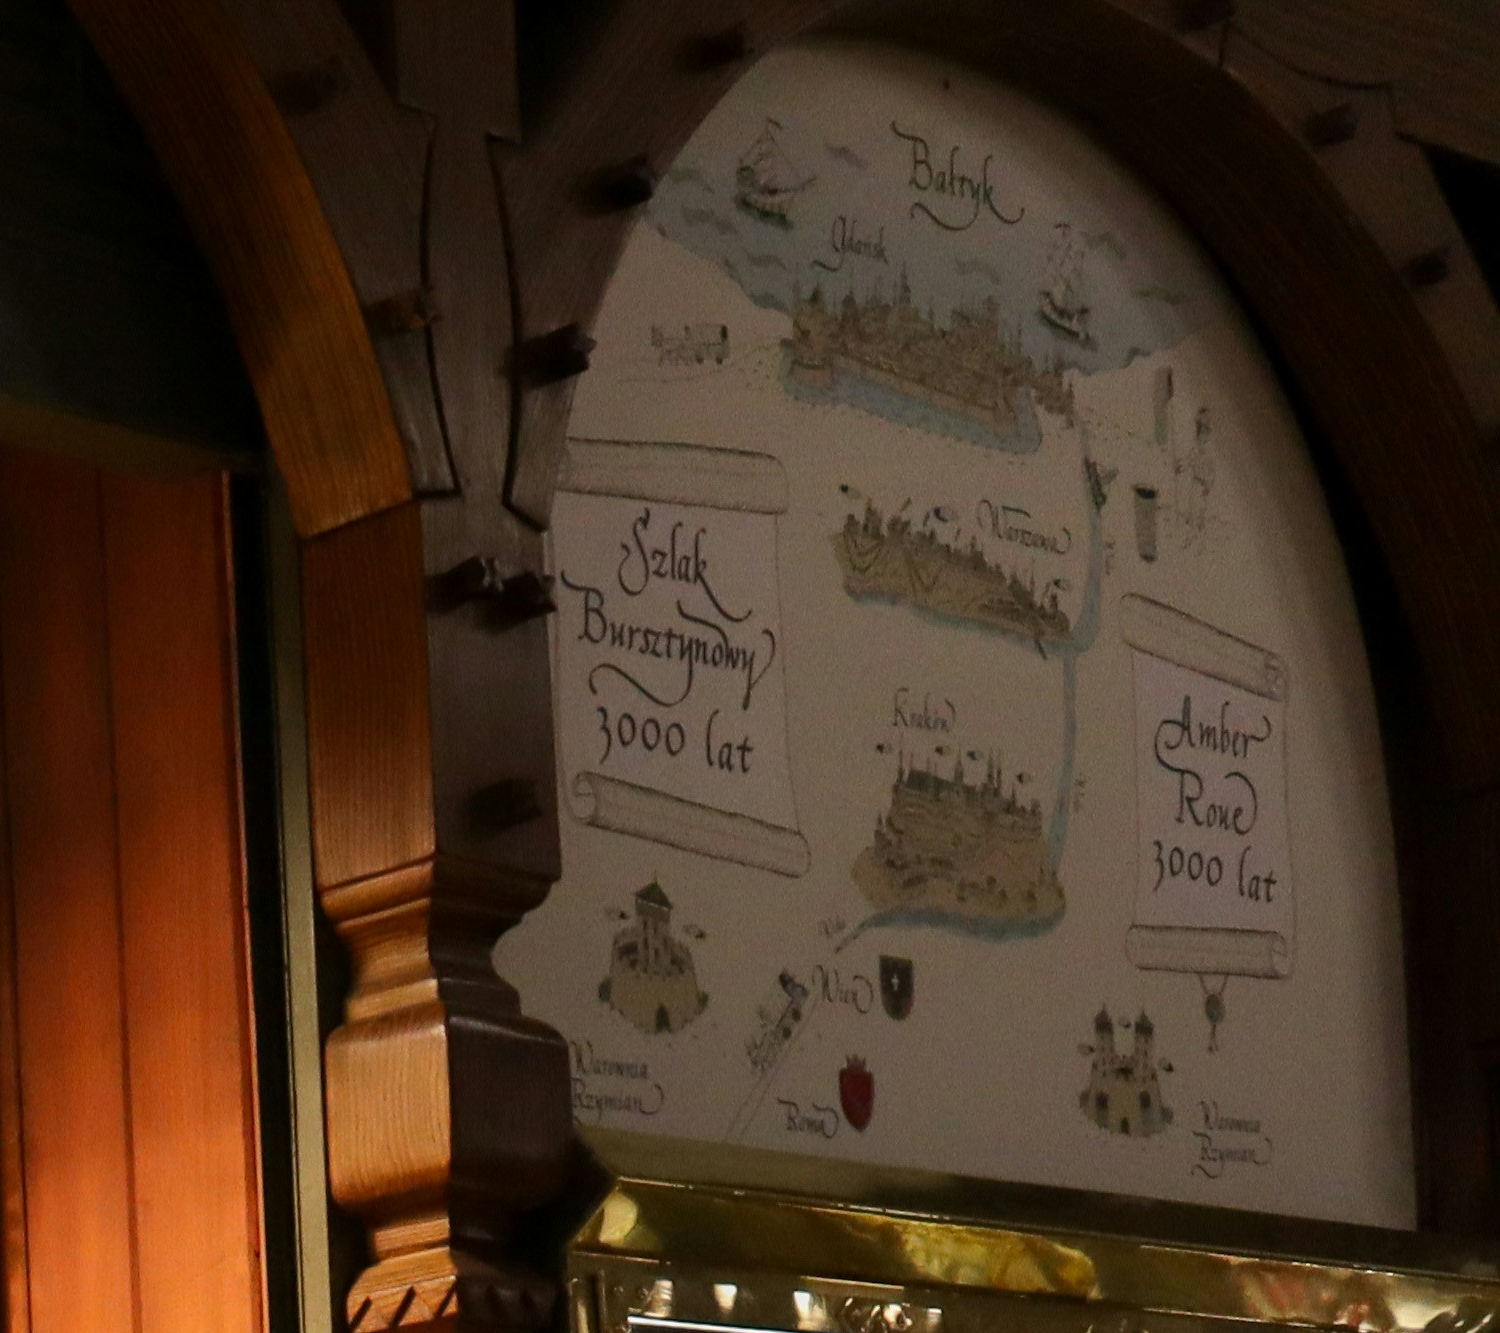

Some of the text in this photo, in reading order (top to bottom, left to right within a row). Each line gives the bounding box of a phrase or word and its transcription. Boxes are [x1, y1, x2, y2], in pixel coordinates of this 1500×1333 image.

[618, 507, 752, 623] Szlak
[560, 569, 776, 711] Bursztynowy
[597, 705, 754, 774] 3000 lat
[1154, 694, 1272, 759] Amber
[1152, 839, 1278, 904] 3000 lat
